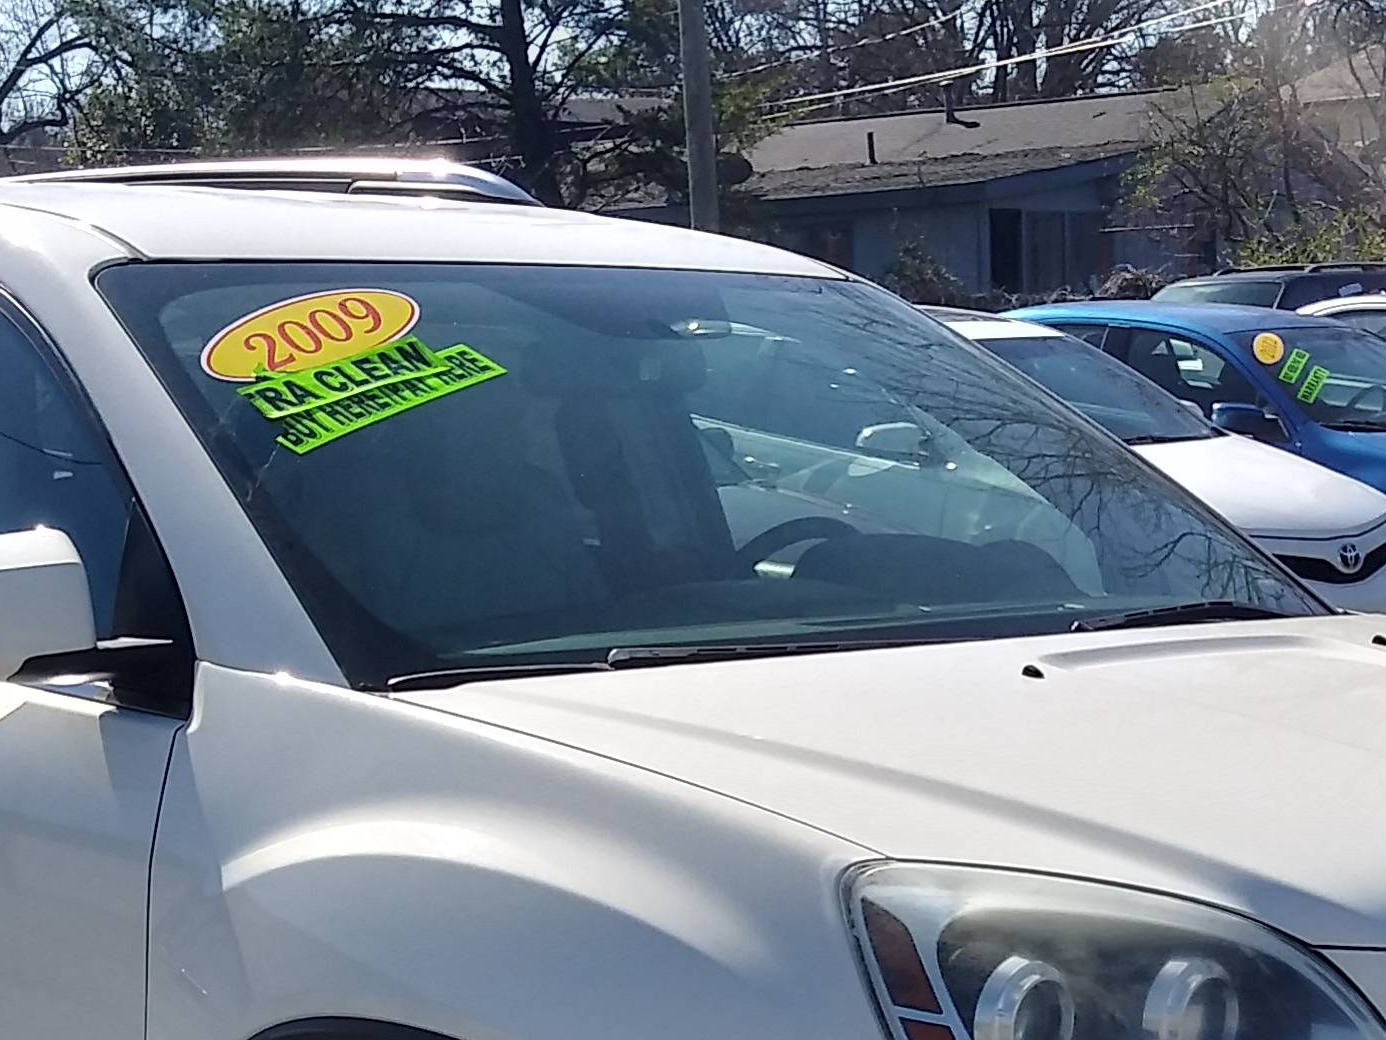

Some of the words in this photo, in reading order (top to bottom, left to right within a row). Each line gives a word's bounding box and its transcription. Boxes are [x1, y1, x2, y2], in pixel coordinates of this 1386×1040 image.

[243, 297, 382, 372] 2009
[313, 340, 433, 392] CLEAN
[281, 406, 335, 447] BUY
